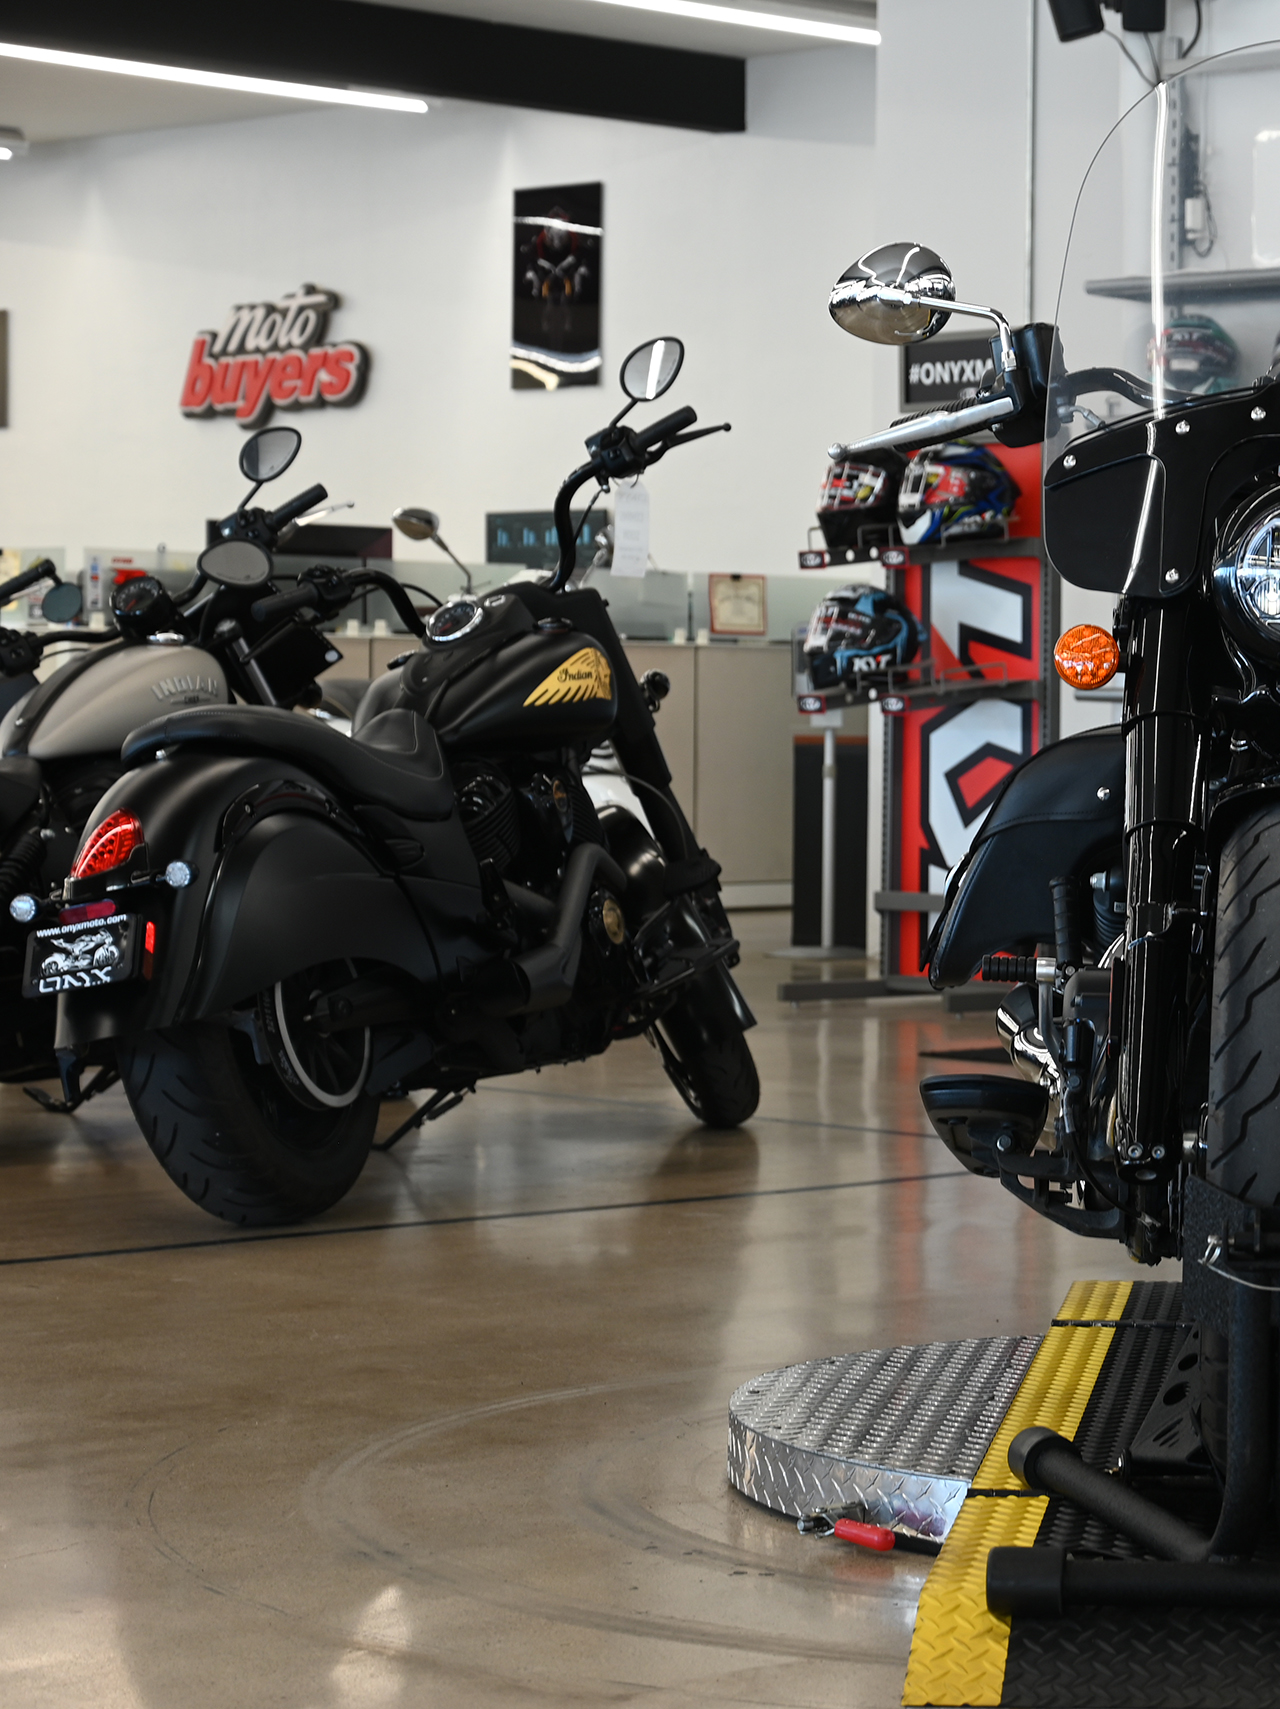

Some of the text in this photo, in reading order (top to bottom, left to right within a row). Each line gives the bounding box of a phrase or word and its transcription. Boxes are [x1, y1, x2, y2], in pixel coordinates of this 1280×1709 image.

[179, 334, 358, 421] buyers
[557, 667, 594, 682] Indian
[853, 654, 892, 673] KYT
[37, 914, 126, 938] www.onyxmoto.com
[39, 966, 112, 993] ONYX
